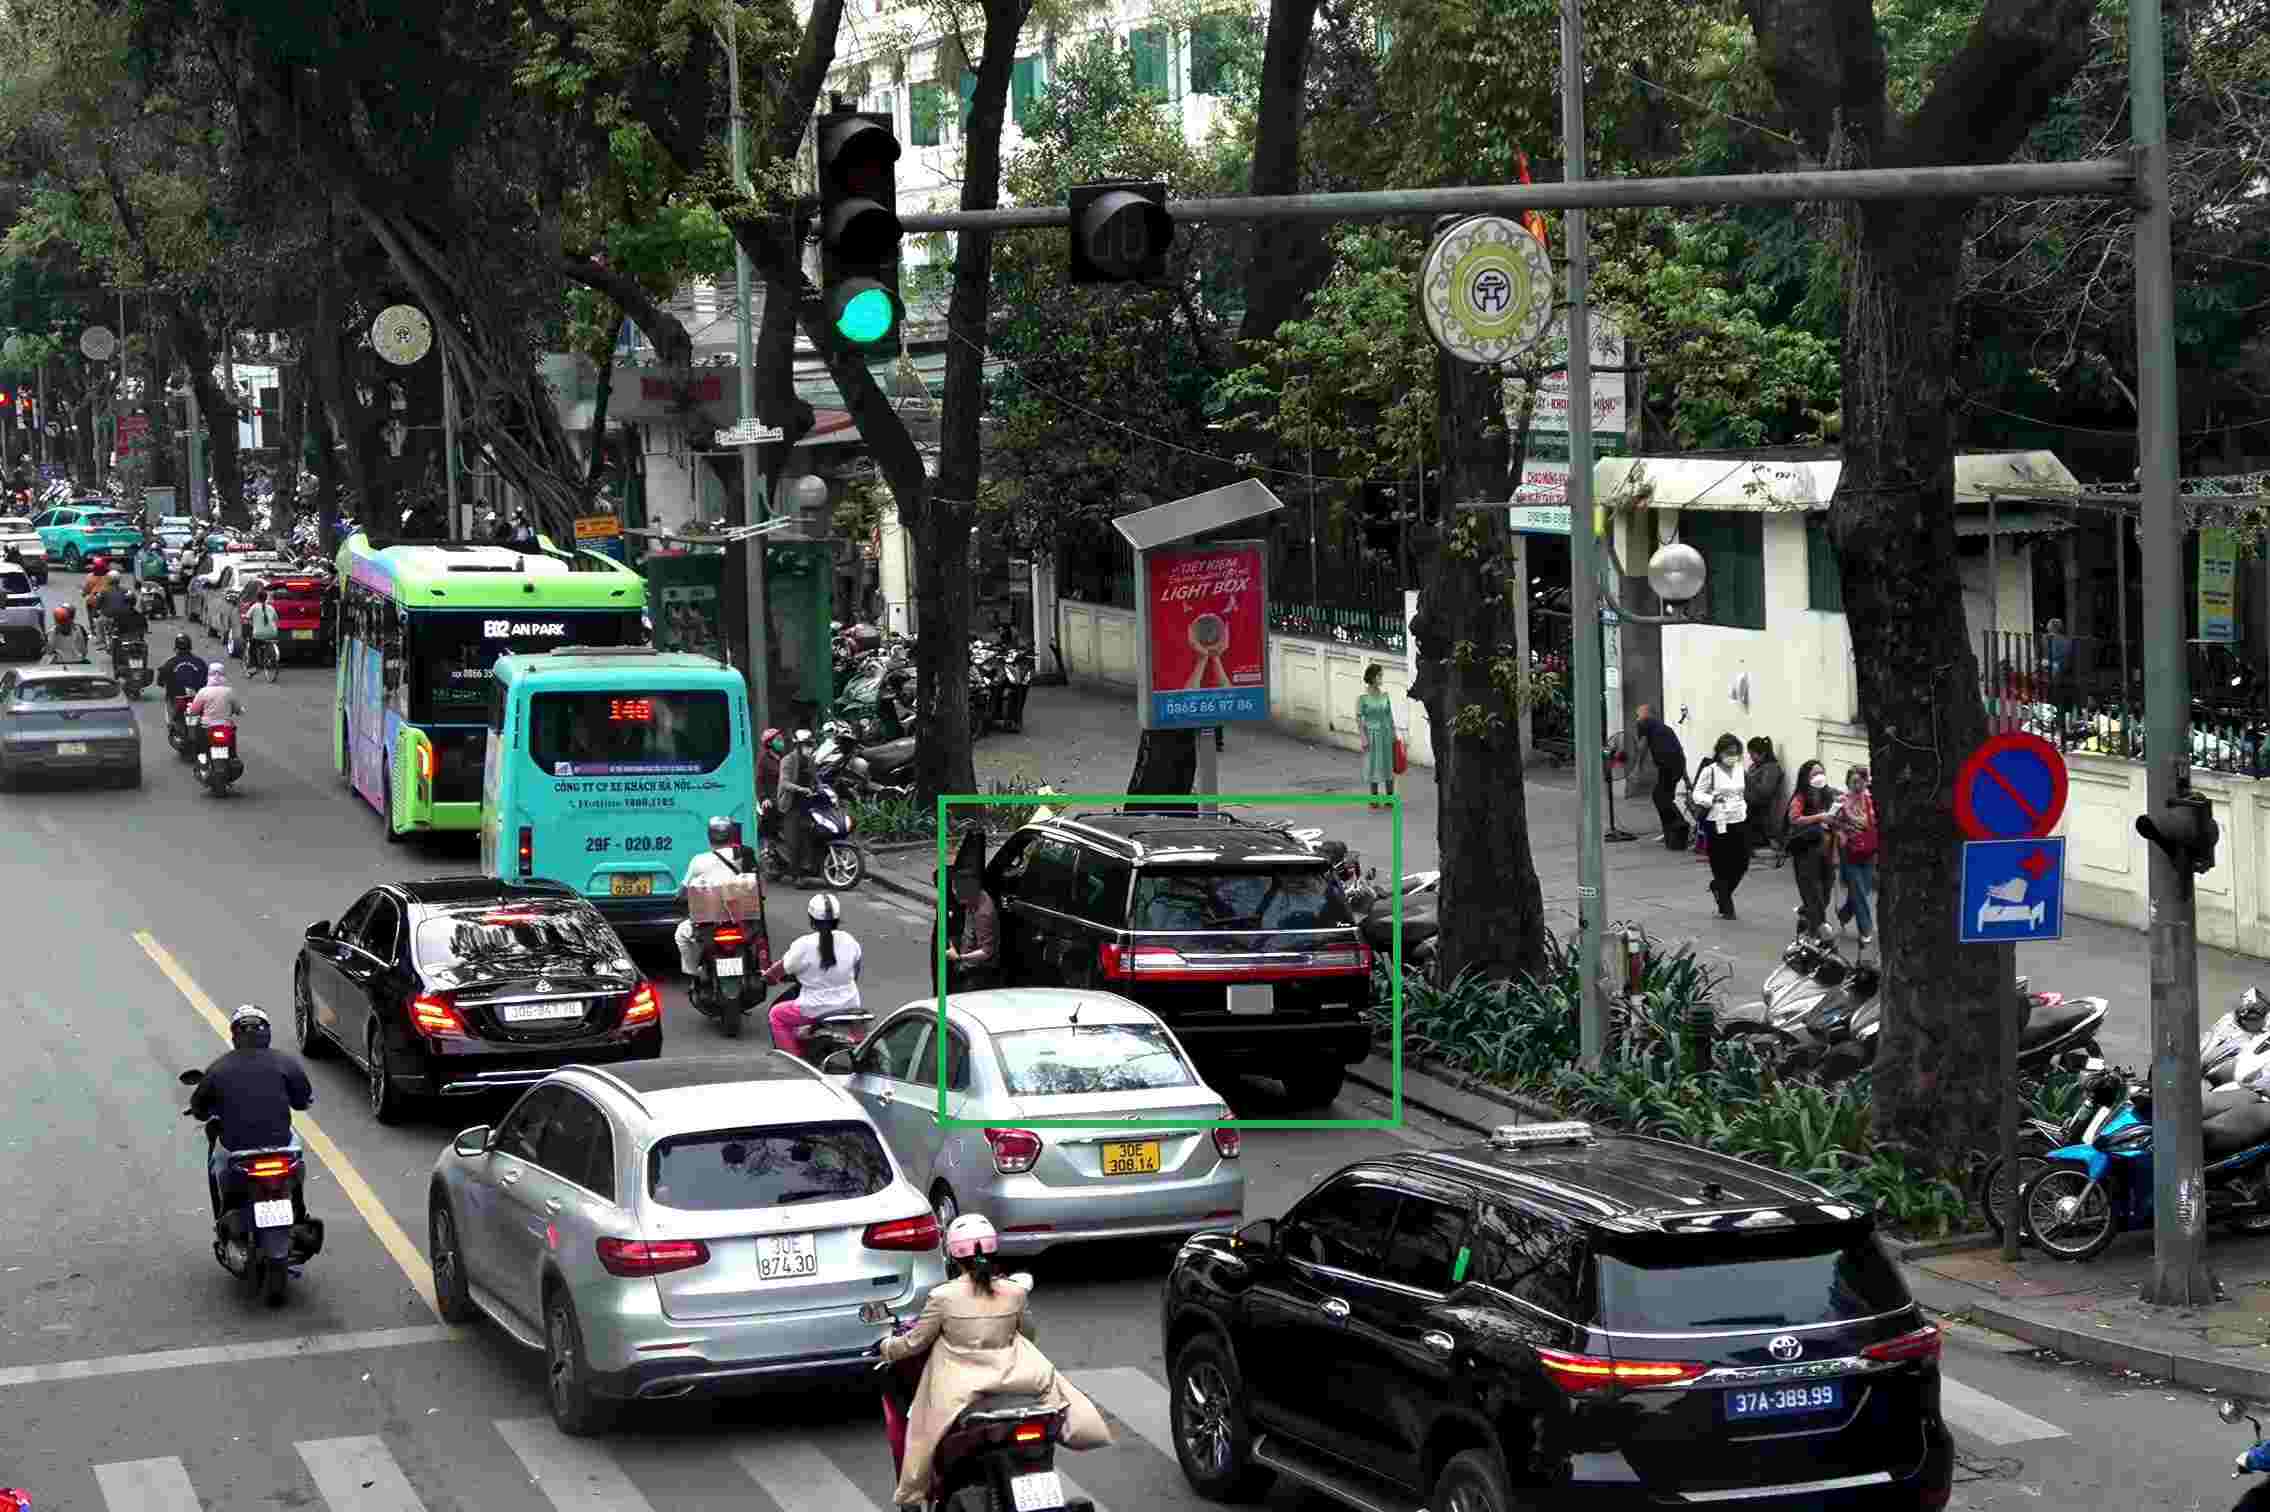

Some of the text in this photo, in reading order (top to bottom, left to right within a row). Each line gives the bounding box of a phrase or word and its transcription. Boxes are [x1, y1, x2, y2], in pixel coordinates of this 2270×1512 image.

[1160, 577, 1248, 601] LIGHT BOX
[512, 623, 531, 635] AN
[531, 623, 565, 635] PARK
[1119, 1143, 1144, 1157] 30E
[1107, 1156, 1154, 1172] 308.14
[761, 1254, 816, 1276] 874.30
[1735, 1385, 1833, 1413] 37A-389.99
